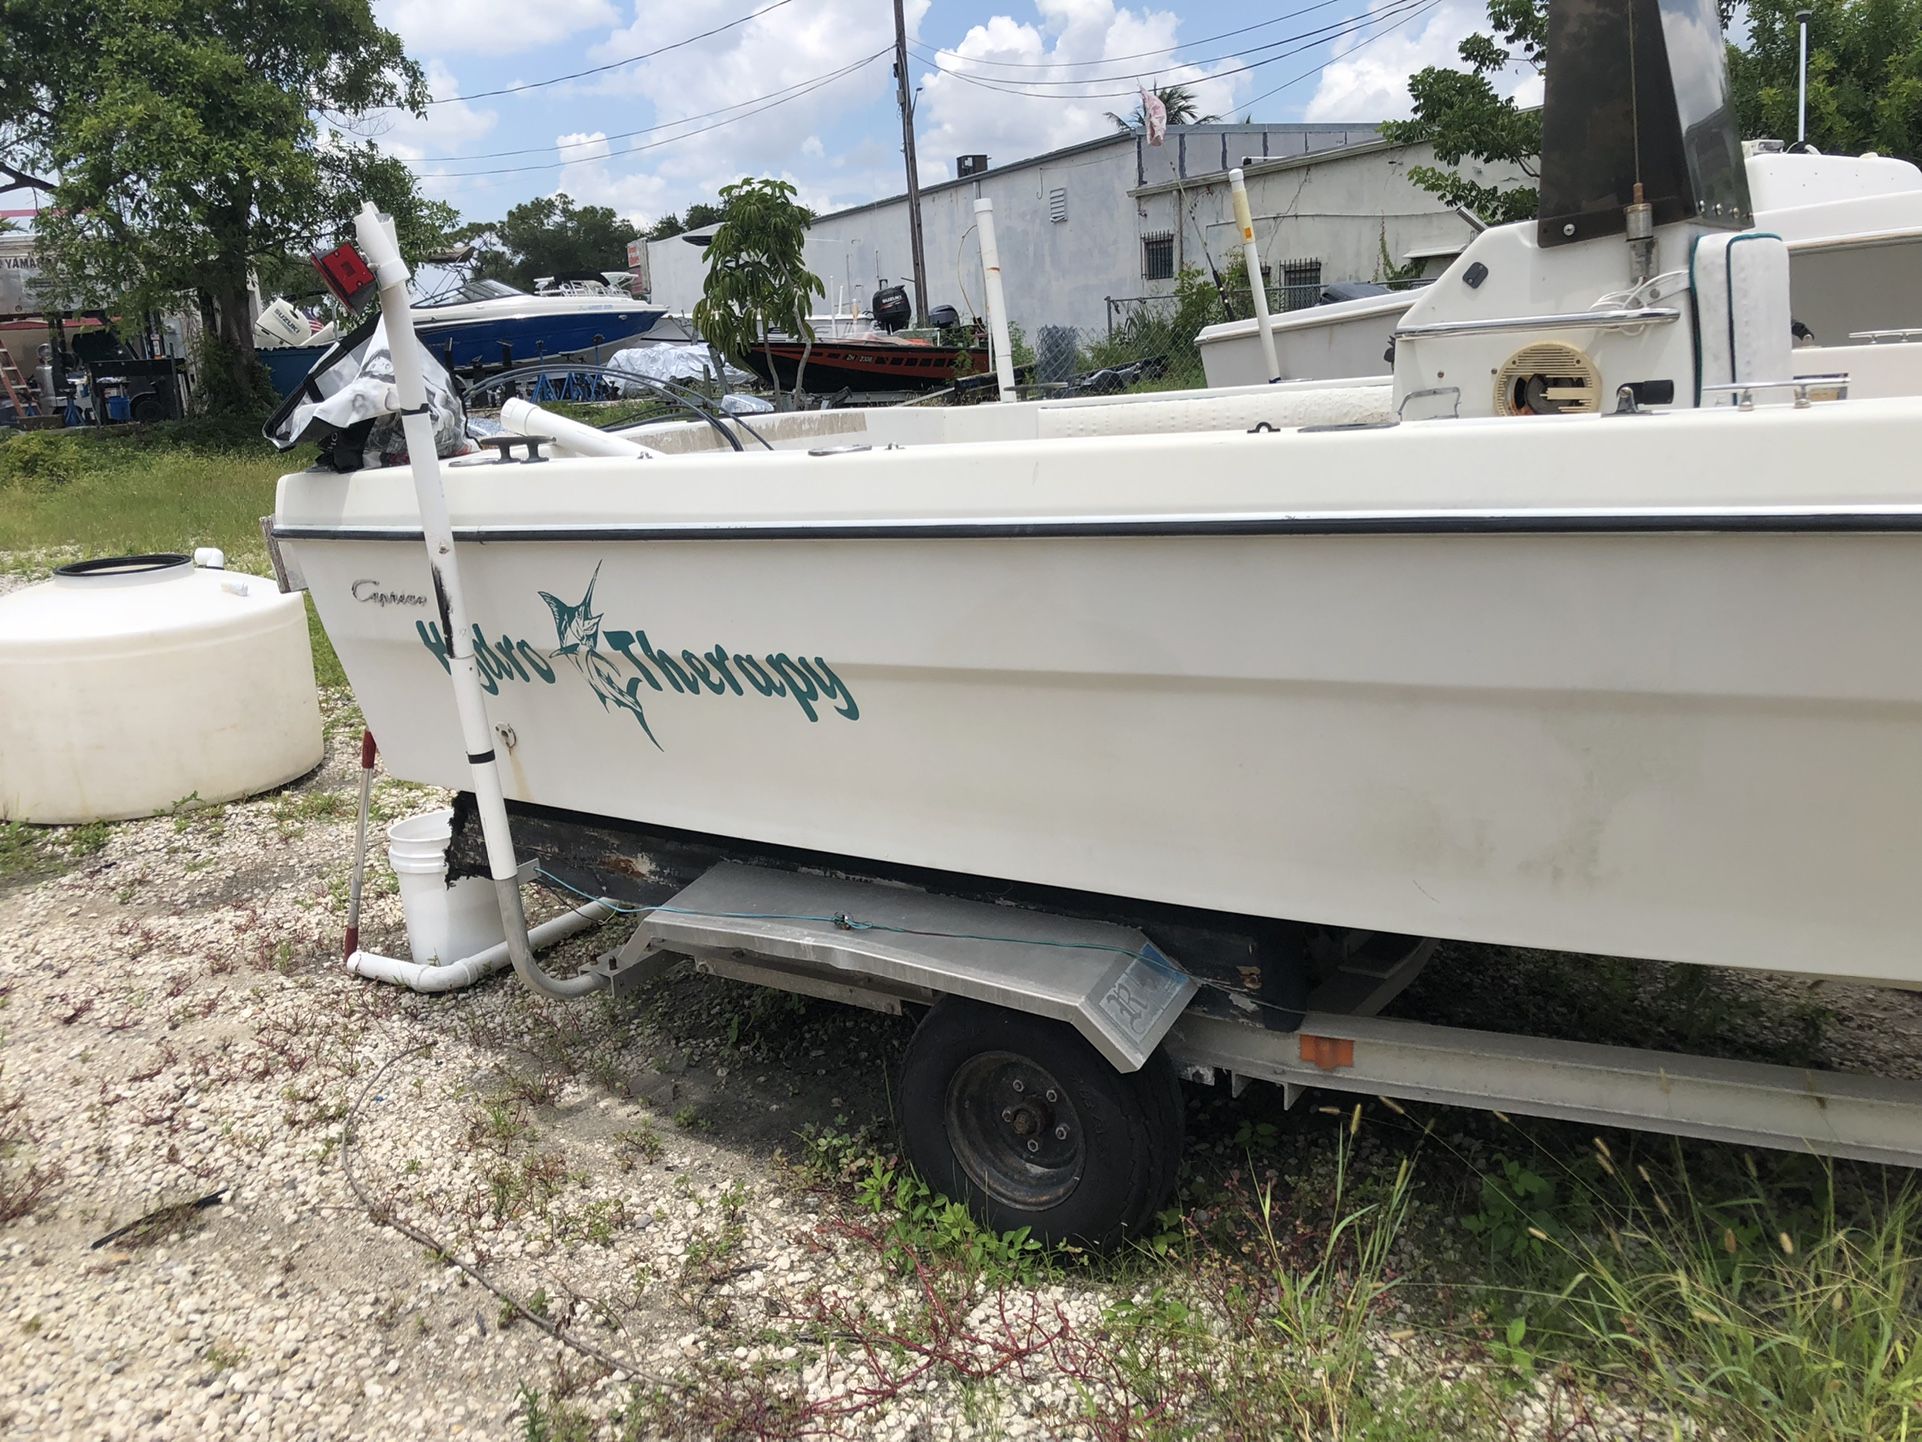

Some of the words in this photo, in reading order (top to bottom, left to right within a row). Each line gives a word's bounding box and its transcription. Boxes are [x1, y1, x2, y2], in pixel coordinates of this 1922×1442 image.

[5, 257, 38, 269] YAMA
[274, 308, 301, 334] SUZUKI
[602, 629, 860, 723] Therapy
